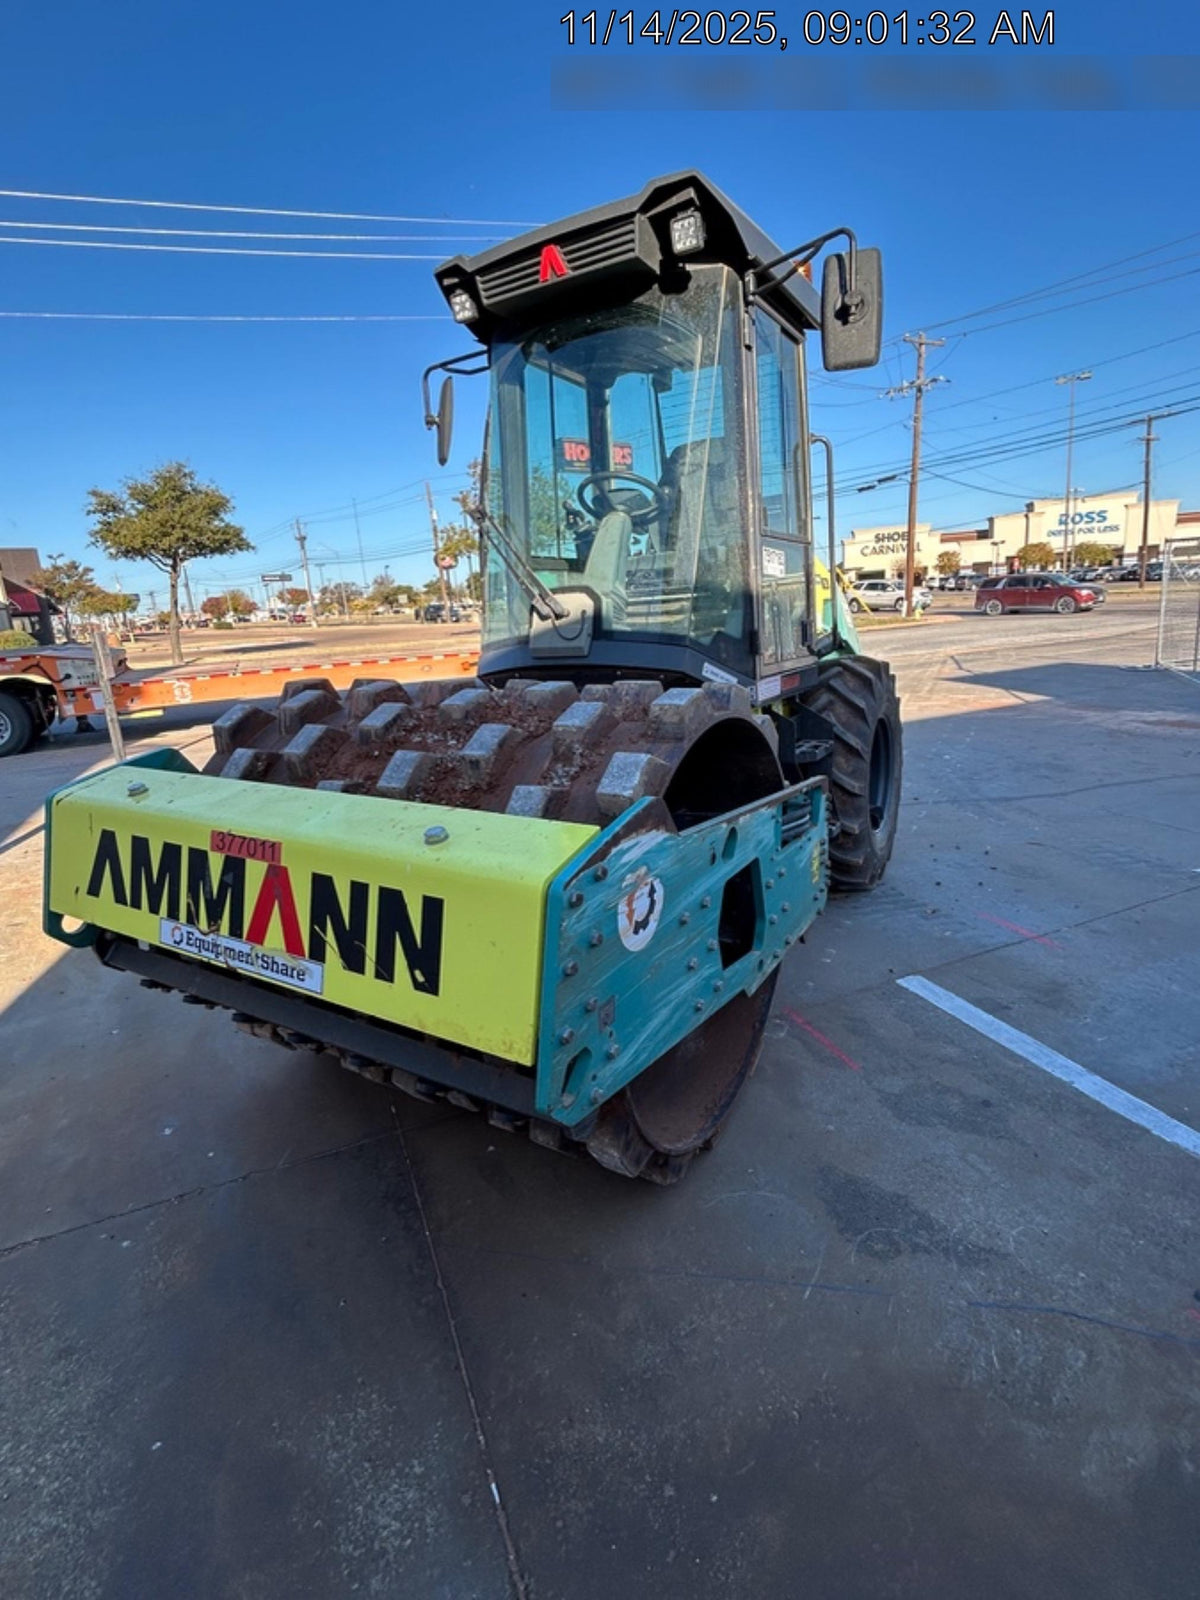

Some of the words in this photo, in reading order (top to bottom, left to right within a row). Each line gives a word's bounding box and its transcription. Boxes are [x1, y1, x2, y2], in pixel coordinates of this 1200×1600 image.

[1058, 510, 1108, 526] ROSS
[860, 541, 922, 557] CARNIVL
[874, 531, 910, 544] SHOE
[215, 831, 277, 862] 377011
[86, 828, 445, 997] AMMANN
[185, 930, 307, 983] EquipmentShare
